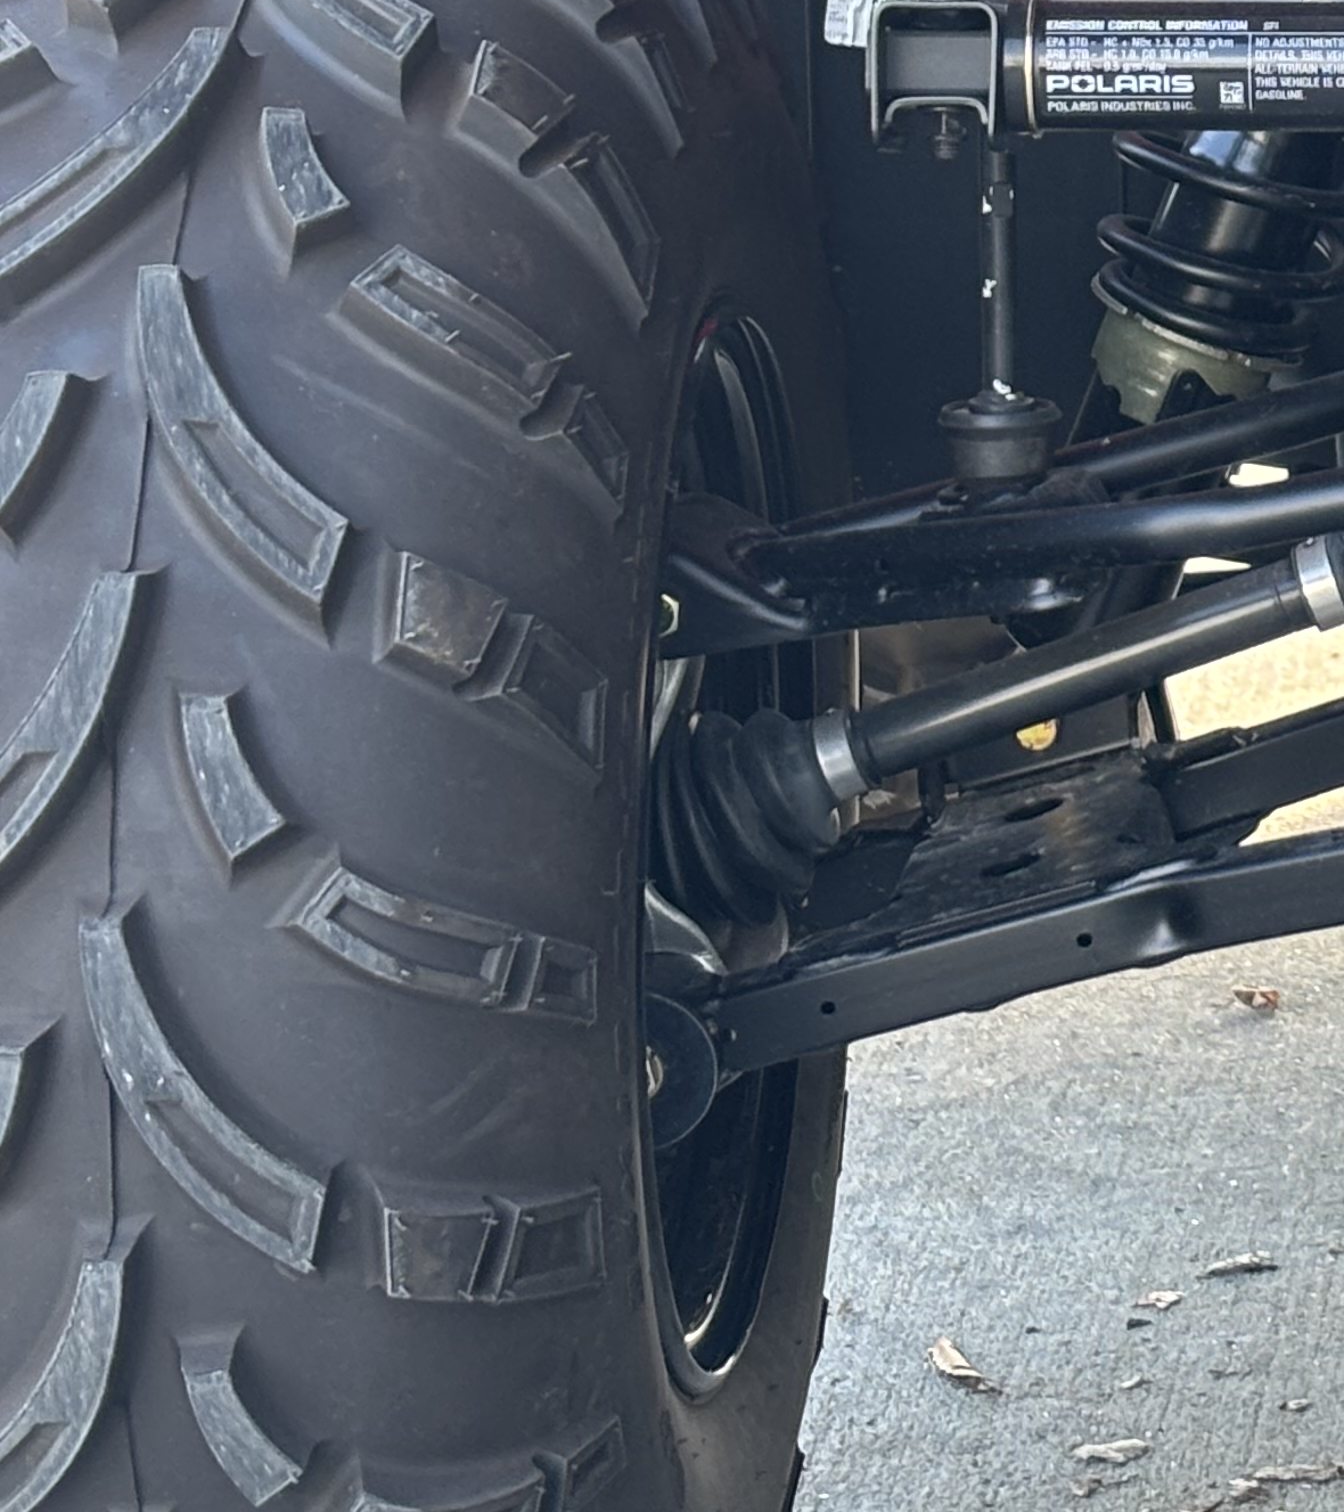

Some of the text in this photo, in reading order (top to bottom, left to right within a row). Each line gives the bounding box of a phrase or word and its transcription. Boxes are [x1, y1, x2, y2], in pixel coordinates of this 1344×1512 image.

[1046, 20, 1248, 31] EMISSION CONTROL INFORMATION
[1176, 37, 1190, 47] CO
[1255, 37, 1270, 47] NO
[1272, 37, 1344, 48] ADJUSTMENTS
[1046, 74, 1196, 93] POLARIS
[1255, 76, 1277, 88] THIS
[1280, 76, 1320, 88] VEHICLE
[1323, 76, 1333, 88] IS
[1047, 101, 1196, 112] POLARIS INDUSTRIES INC.
